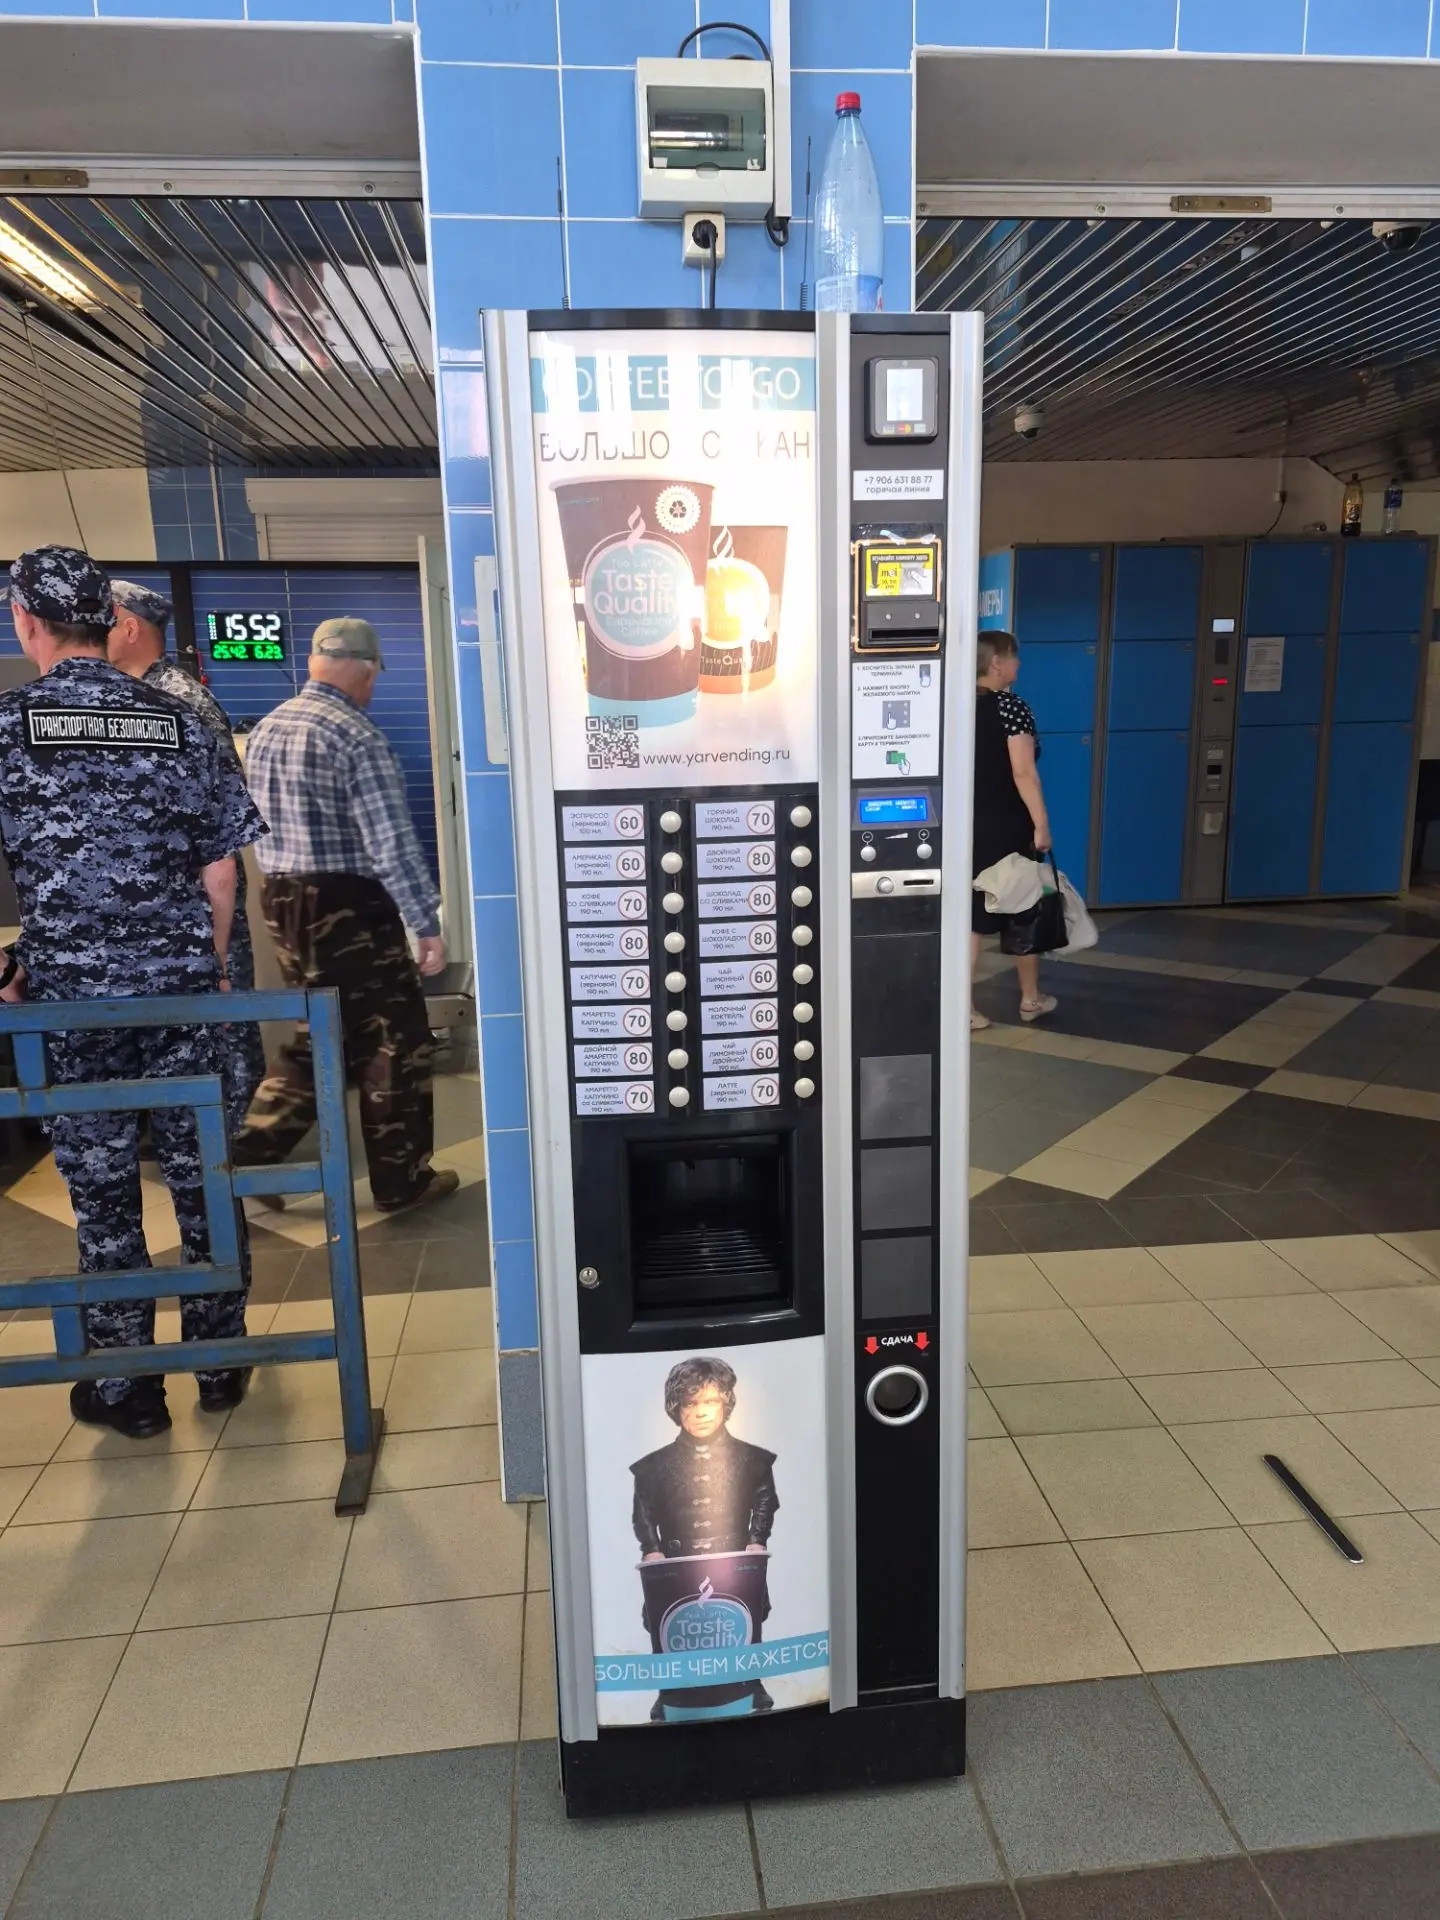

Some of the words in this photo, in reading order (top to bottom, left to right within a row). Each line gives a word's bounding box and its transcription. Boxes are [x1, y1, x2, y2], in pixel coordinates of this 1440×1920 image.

[752, 366, 801, 400] GO
[864, 476, 874, 484] +7
[876, 476, 892, 484] 906
[895, 476, 908, 484] 631
[911, 476, 921, 484] 88
[866, 486, 902, 494] горячая
[602, 569, 674, 593] Taste
[594, 591, 671, 615] Qualit
[33, 716, 105, 737] ТРАНСПОРТНАЯ
[108, 718, 175, 741] БЕЗОПАСНОСТЬ
[643, 748, 790, 767] www.yarvending.ru
[620, 816, 638, 829] 60
[752, 813, 770, 826] 70
[622, 858, 640, 871] 60
[753, 853, 770, 865] 80
[624, 899, 642, 911] 70
[753, 893, 771, 906] 80
[625, 937, 643, 950] 80
[754, 933, 772, 945] 80
[626, 977, 644, 989] 70
[755, 971, 772, 983] 60
[629, 1016, 646, 1027] 70
[756, 1010, 773, 1022] 60
[630, 1052, 647, 1065] 80
[756, 1047, 774, 1059] 60
[757, 1085, 774, 1097] 70
[631, 1092, 648, 1104] 70
[881, 1335, 913, 1346] СДАЧА
[677, 1618, 735, 1636] Taste
[670, 1632, 743, 1651] Quality
[595, 1661, 682, 1681] БОЛЬШЕ
[688, 1657, 728, 1676] ЧЕМ
[735, 1639, 829, 1669] КАЖЕТСЯ
